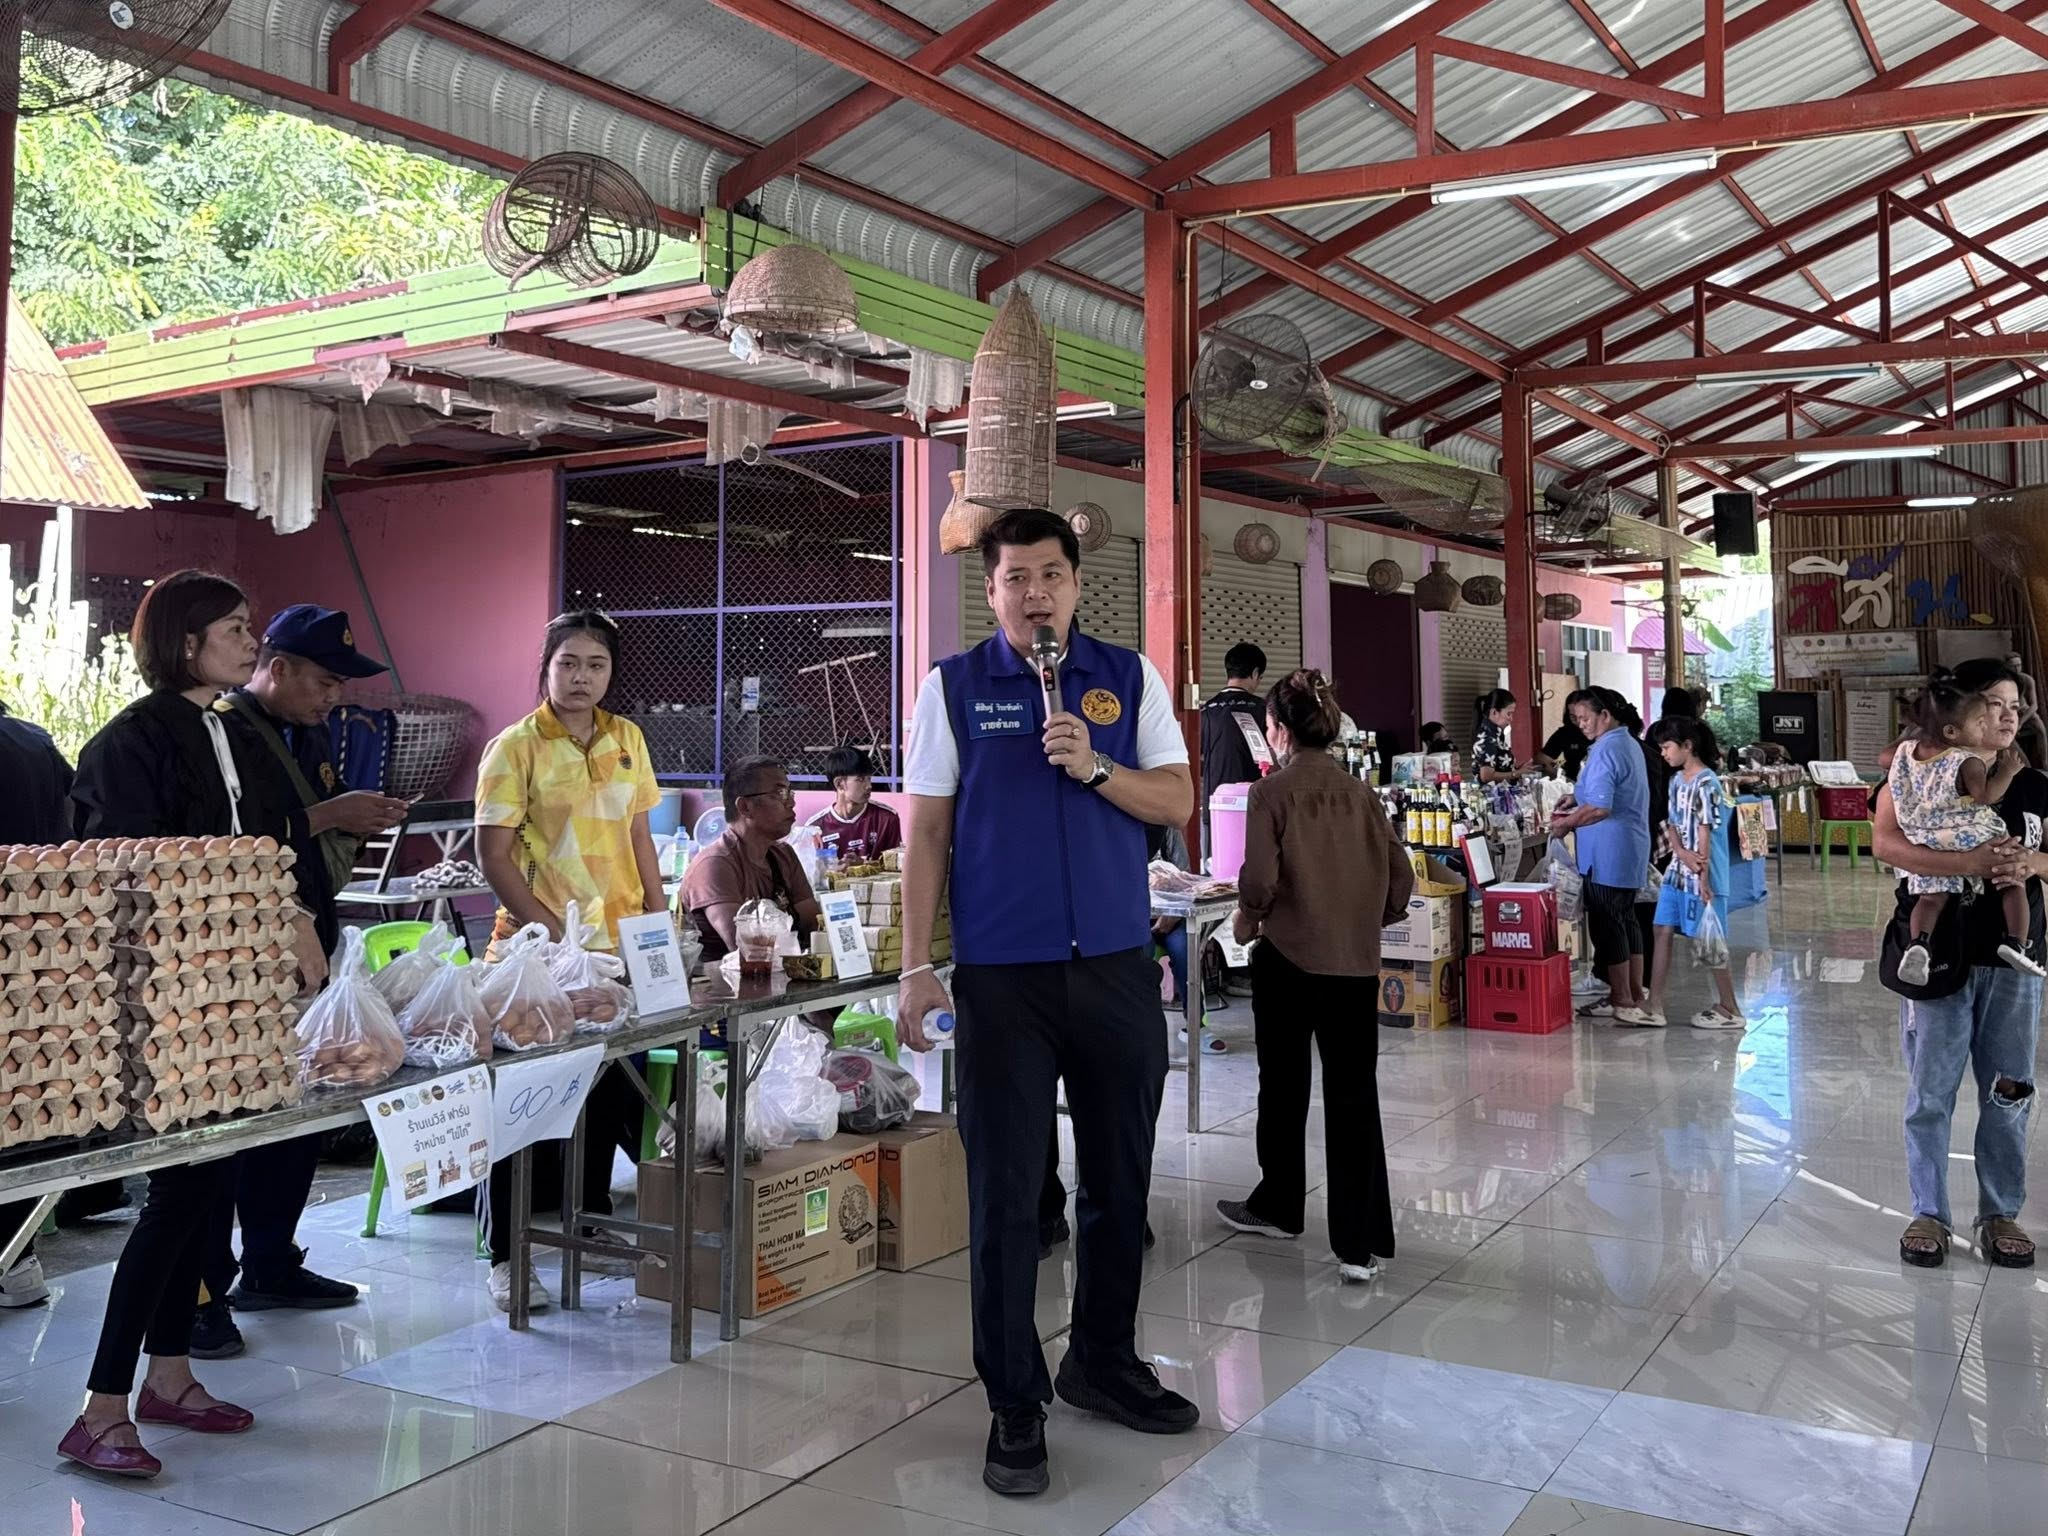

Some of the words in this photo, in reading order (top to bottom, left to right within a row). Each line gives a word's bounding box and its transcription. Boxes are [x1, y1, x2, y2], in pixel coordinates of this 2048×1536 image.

[980, 718, 1021, 731] นายอำเภอ
[1775, 718, 1801, 728] JST
[1491, 931, 1533, 949] MARVEL
[504, 1085, 554, 1126] 90
[413, 1133, 446, 1152] จำหน่าย
[758, 1175, 799, 1198] SIAM
[804, 1150, 876, 1184] DIAMOND
[758, 1238, 776, 1252] THAI
[777, 1232, 794, 1246] HOM
